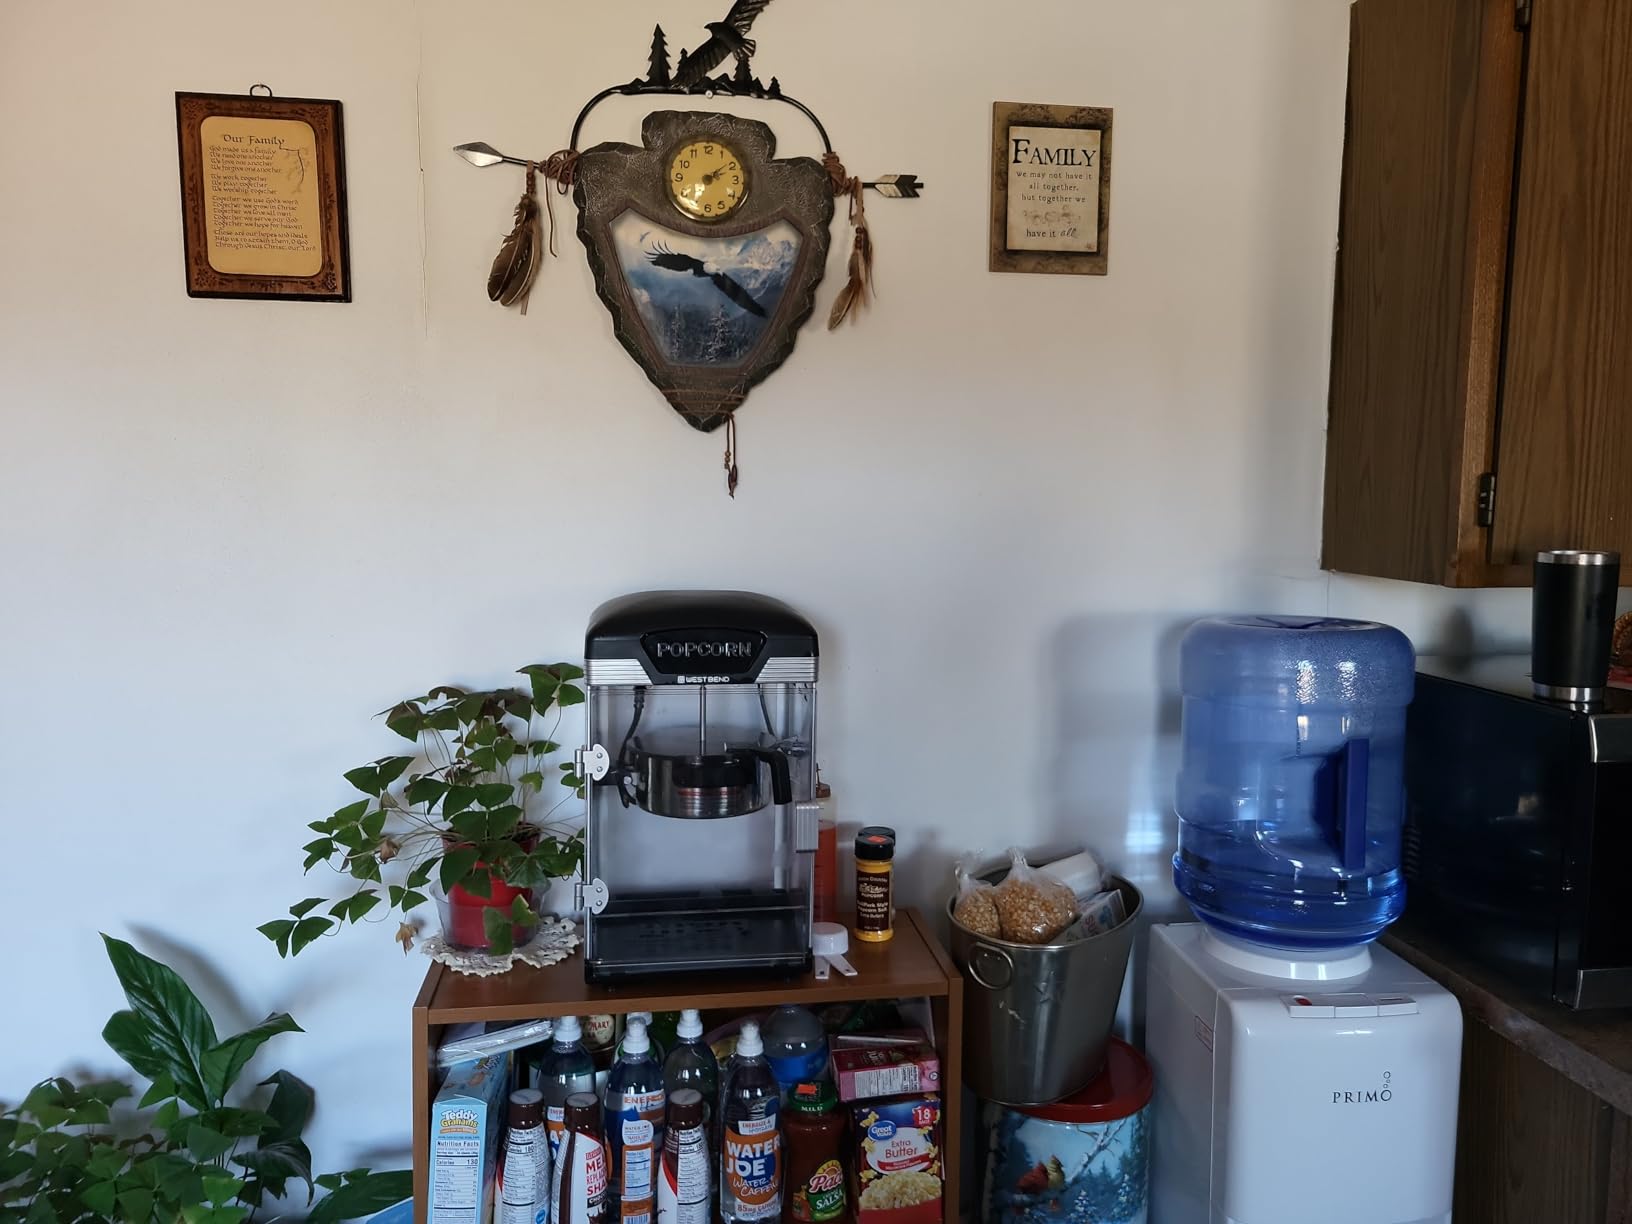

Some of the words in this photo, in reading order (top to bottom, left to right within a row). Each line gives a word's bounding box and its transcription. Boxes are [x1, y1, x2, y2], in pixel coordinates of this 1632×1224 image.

[223, 134, 243, 143] Our
[248, 135, 285, 147] Family
[690, 149, 698, 158] 11
[703, 145, 714, 154] 12
[720, 150, 724, 158] 1
[1011, 138, 1096, 167] FAMILY
[680, 160, 690, 168] 10
[728, 162, 736, 170] 2
[674, 173, 683, 182] 9
[732, 175, 739, 184] 3
[1039, 195, 1072, 204] together
[704, 204, 712, 212] 6
[717, 201, 725, 209] 5
[1026, 228, 1046, 238] have
[657, 642, 752, 657] POPCORN
[1332, 1090, 1392, 1103] PRIMO
[441, 1109, 479, 1120] Teddy
[918, 1108, 931, 1120] 18
[441, 1119, 479, 1128] Grahams
[871, 1126, 892, 1134] Great
[726, 1134, 781, 1158] WATER
[891, 1140, 911, 1148] Extra
[885, 1147, 918, 1158] Butter
[726, 1158, 765, 1177] JOE
